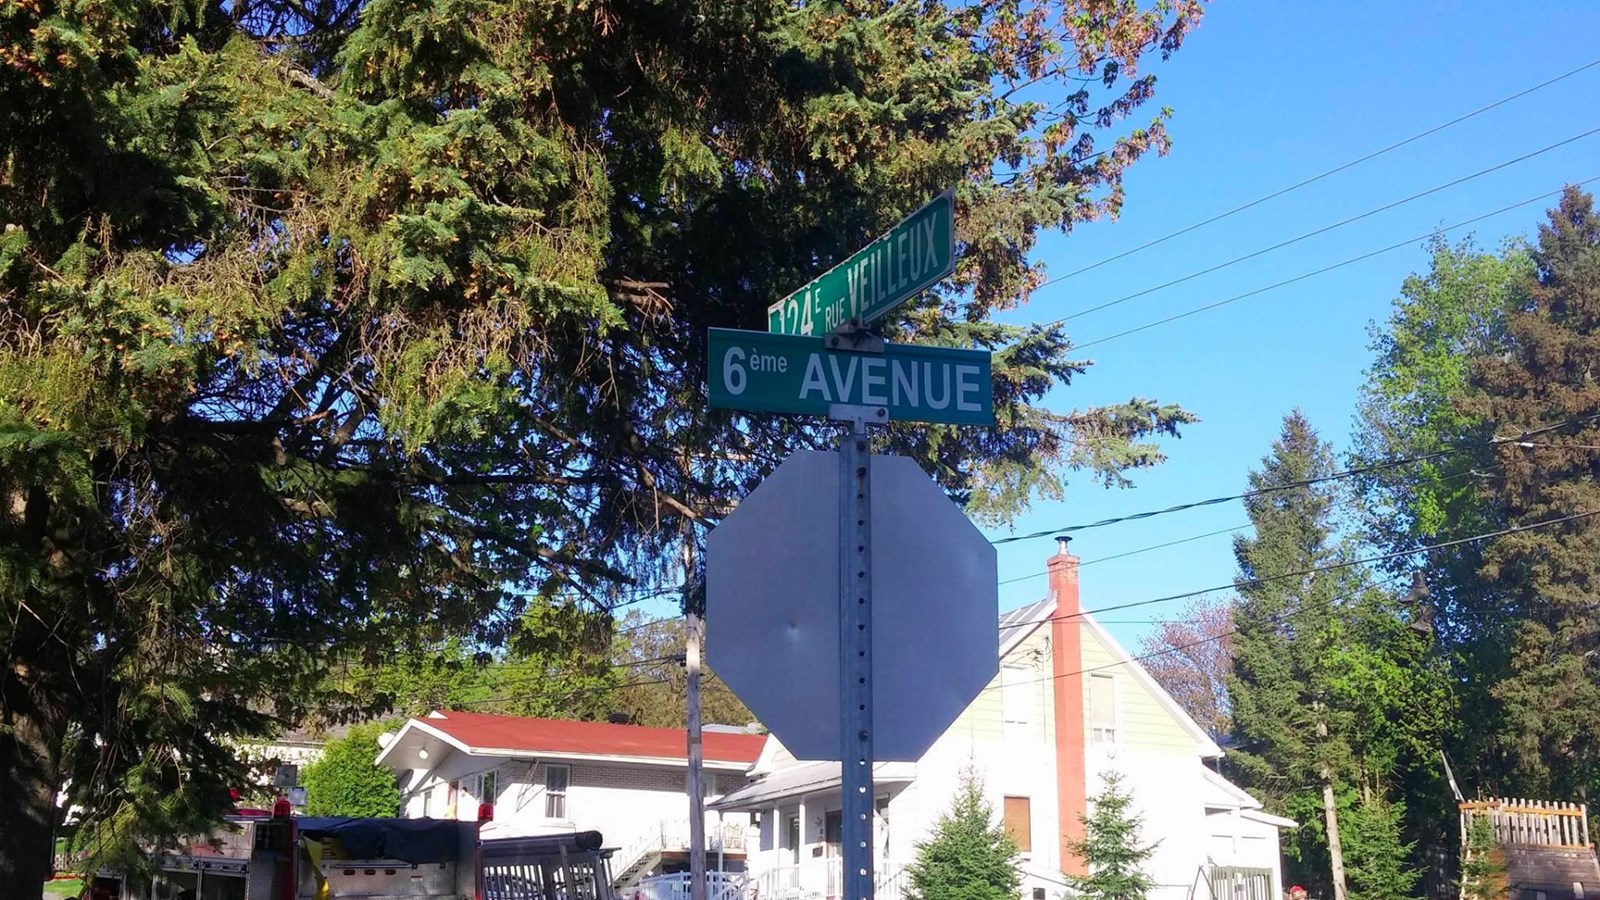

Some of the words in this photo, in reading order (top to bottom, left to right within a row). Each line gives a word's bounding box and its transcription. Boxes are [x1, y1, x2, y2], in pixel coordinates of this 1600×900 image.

[778, 288, 821, 337] 124E
[825, 297, 846, 333] RUE
[847, 210, 939, 318] VEILLEUX
[722, 346, 788, 395] 6ème
[799, 352, 983, 412] AVENUE
